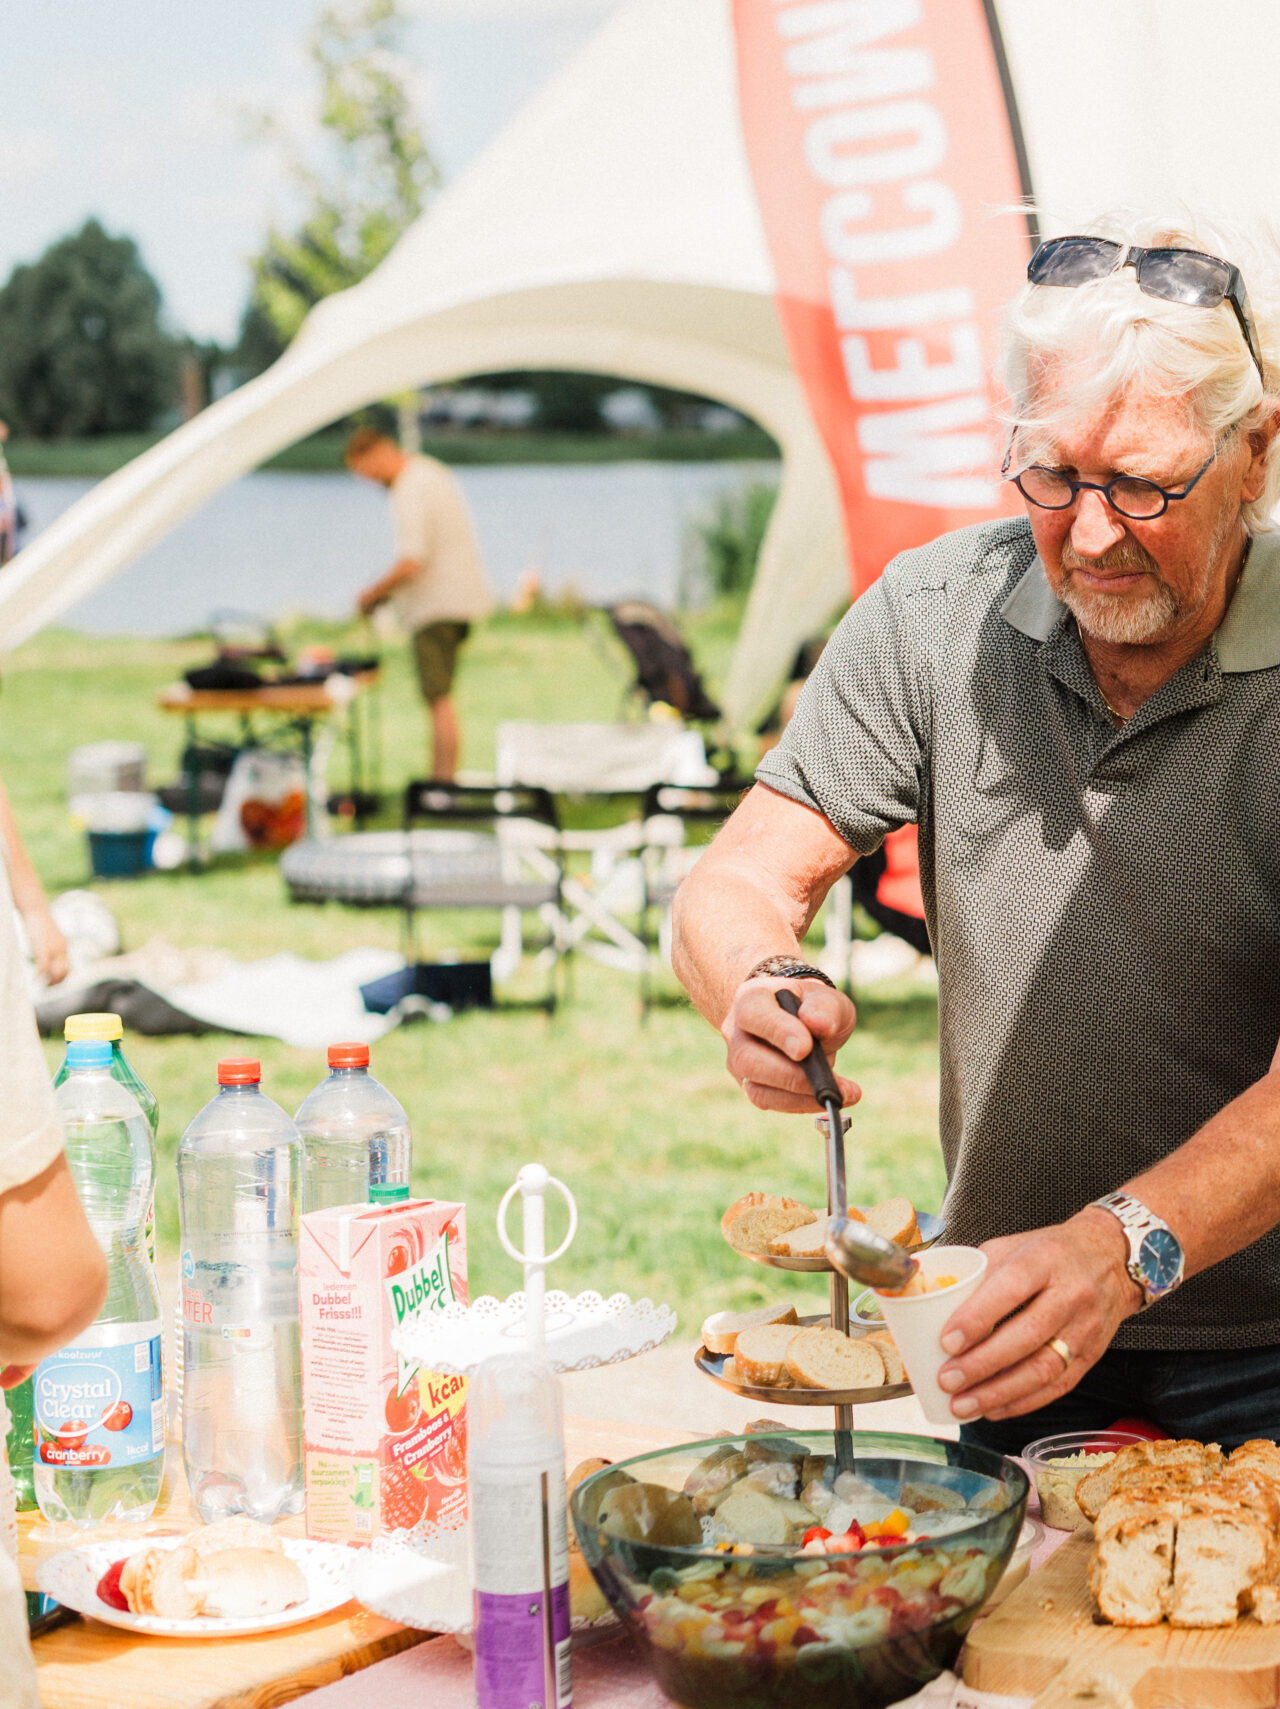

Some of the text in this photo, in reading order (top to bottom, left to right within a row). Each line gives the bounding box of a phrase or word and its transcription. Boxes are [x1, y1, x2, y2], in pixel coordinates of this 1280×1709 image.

[312, 1292, 351, 1306] Dubbel
[392, 1253, 444, 1325] Dubbel
[319, 1306, 362, 1320] Frisss!!!
[40, 1378, 113, 1399] Crystal
[43, 1398, 96, 1419] Clear
[392, 1420, 442, 1458] Framboos
[403, 1425, 453, 1466] Cranberry
[46, 1448, 106, 1462] cranberry
